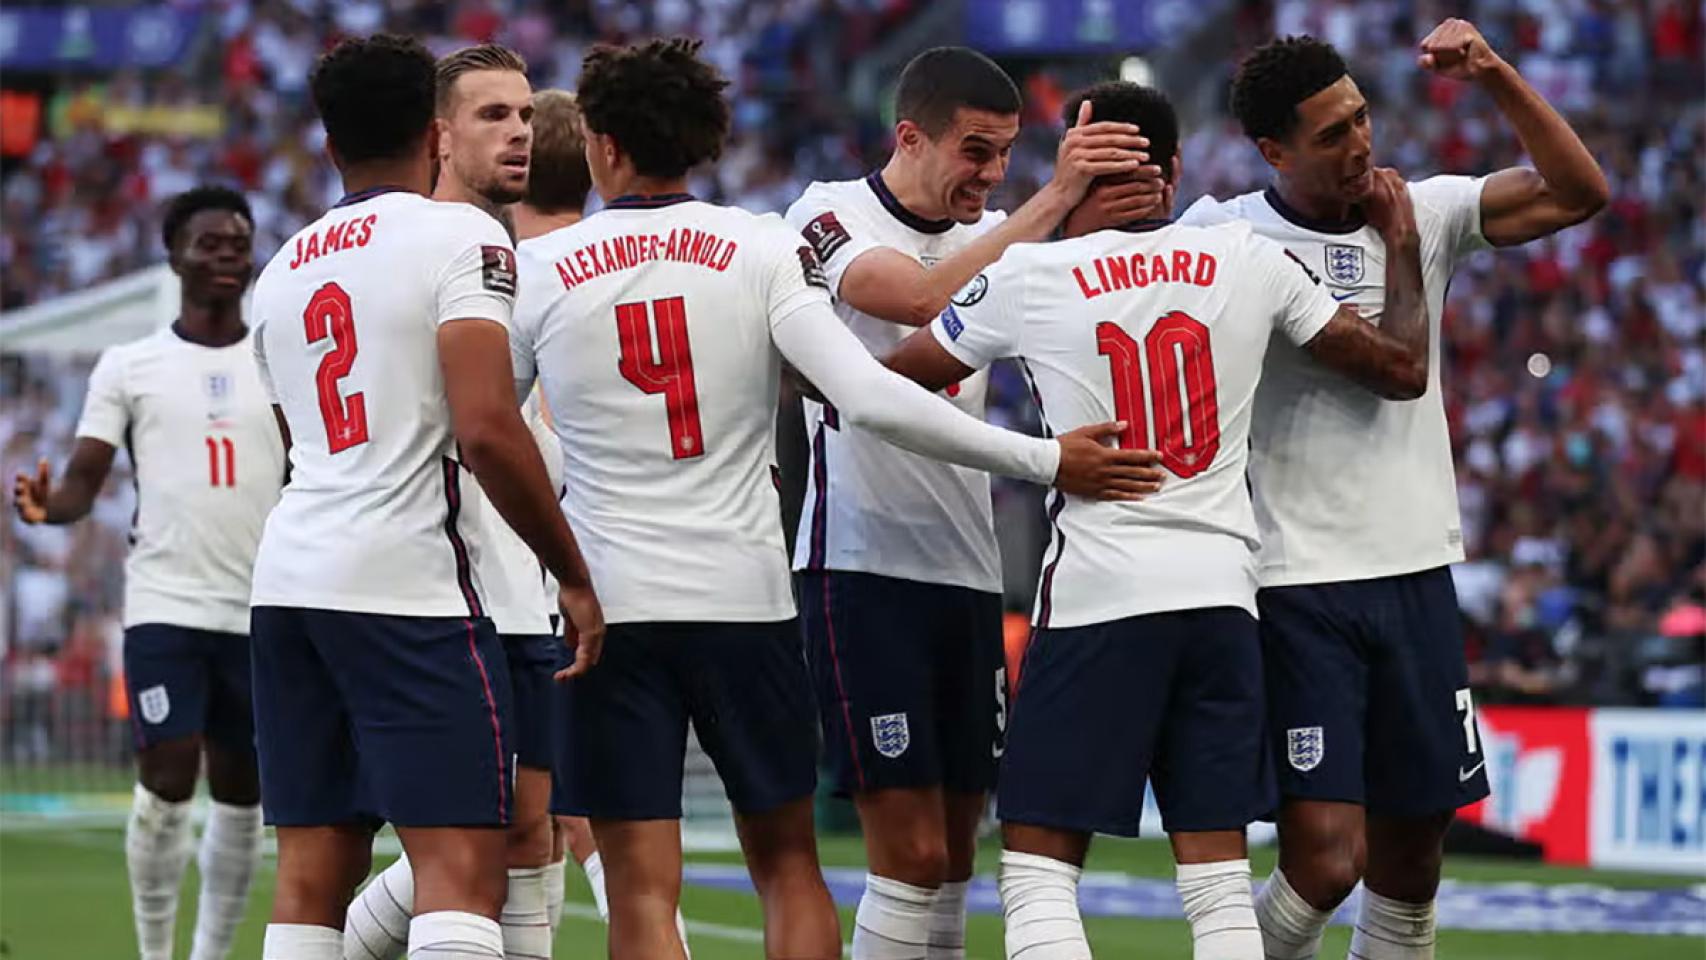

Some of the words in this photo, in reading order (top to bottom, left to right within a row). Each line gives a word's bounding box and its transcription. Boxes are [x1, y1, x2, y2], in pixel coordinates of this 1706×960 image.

[289, 214, 377, 270] JAMES
[555, 228, 738, 291] ALEXANDER-ARNOLD
[1072, 249, 1217, 300] LINGARD
[303, 281, 369, 455] 2
[615, 295, 705, 460] 4
[1096, 310, 1220, 479] 10
[205, 436, 236, 488] 11
[1455, 687, 1477, 754] 7
